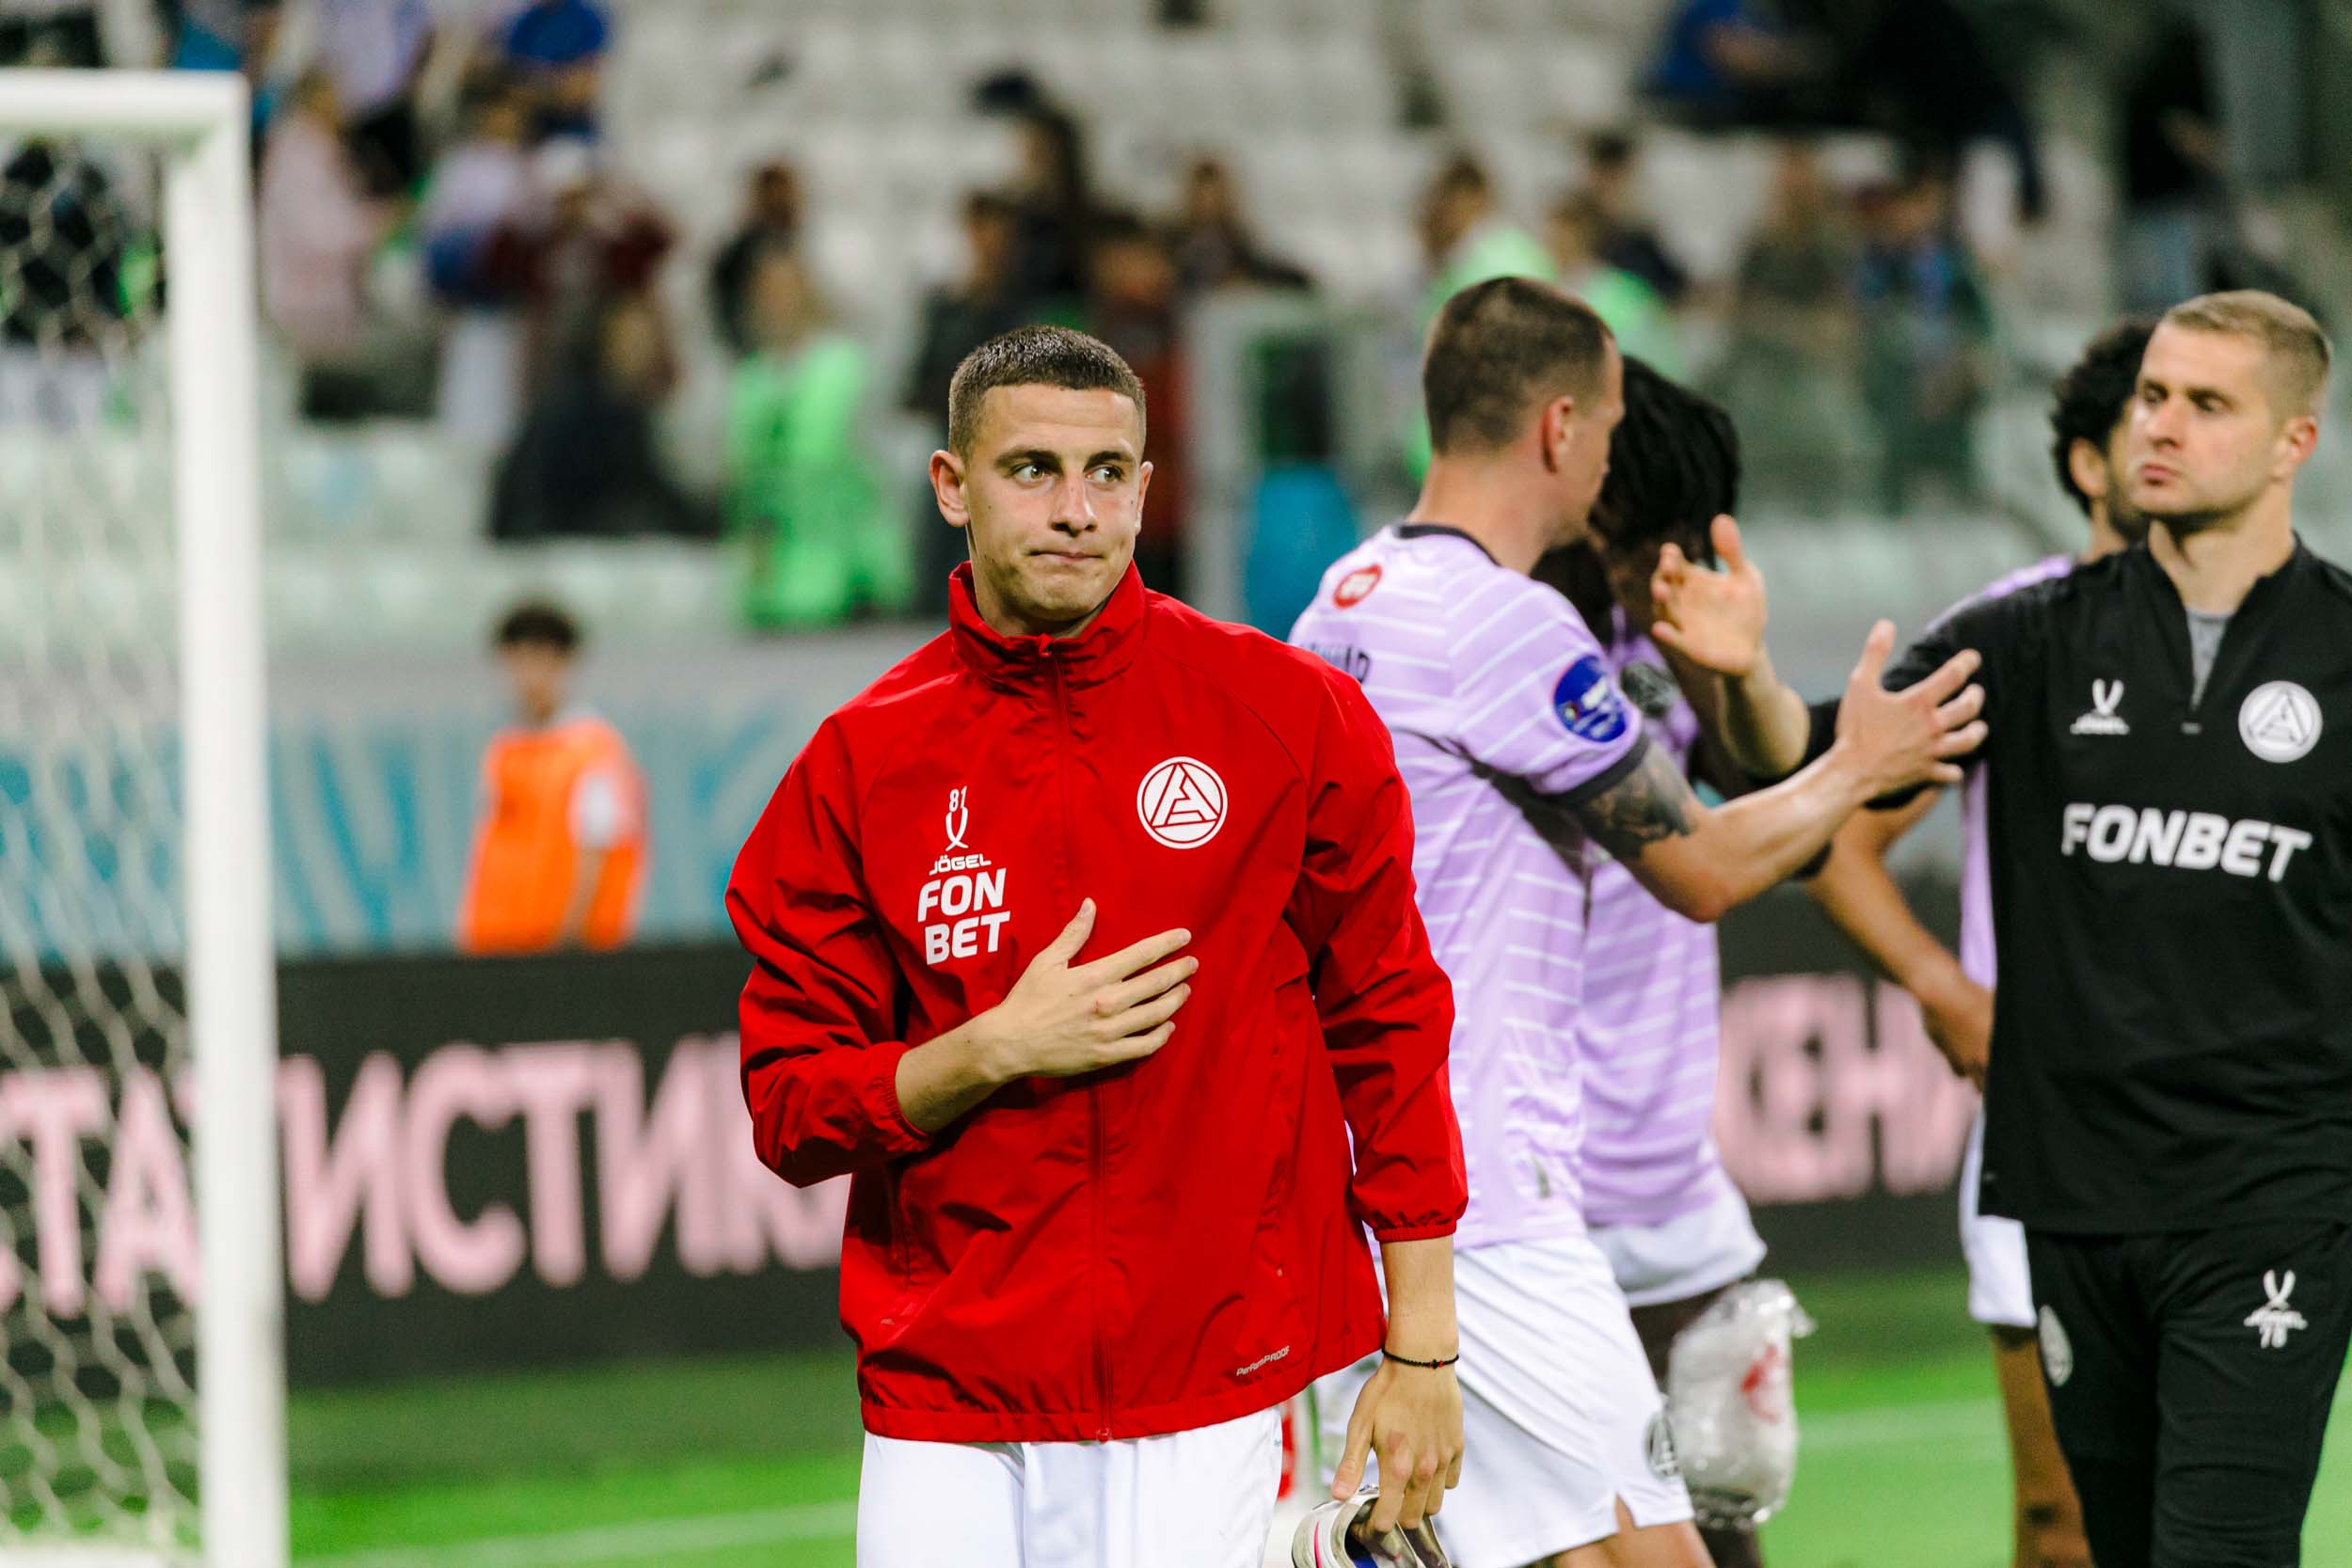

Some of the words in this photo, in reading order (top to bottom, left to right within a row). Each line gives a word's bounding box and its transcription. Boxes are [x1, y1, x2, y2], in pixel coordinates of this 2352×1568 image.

[929, 853, 992, 877] JÖGEL
[2061, 803, 2312, 882] FONBET
[917, 867, 1007, 923] FON
[925, 911, 1010, 966] BET
